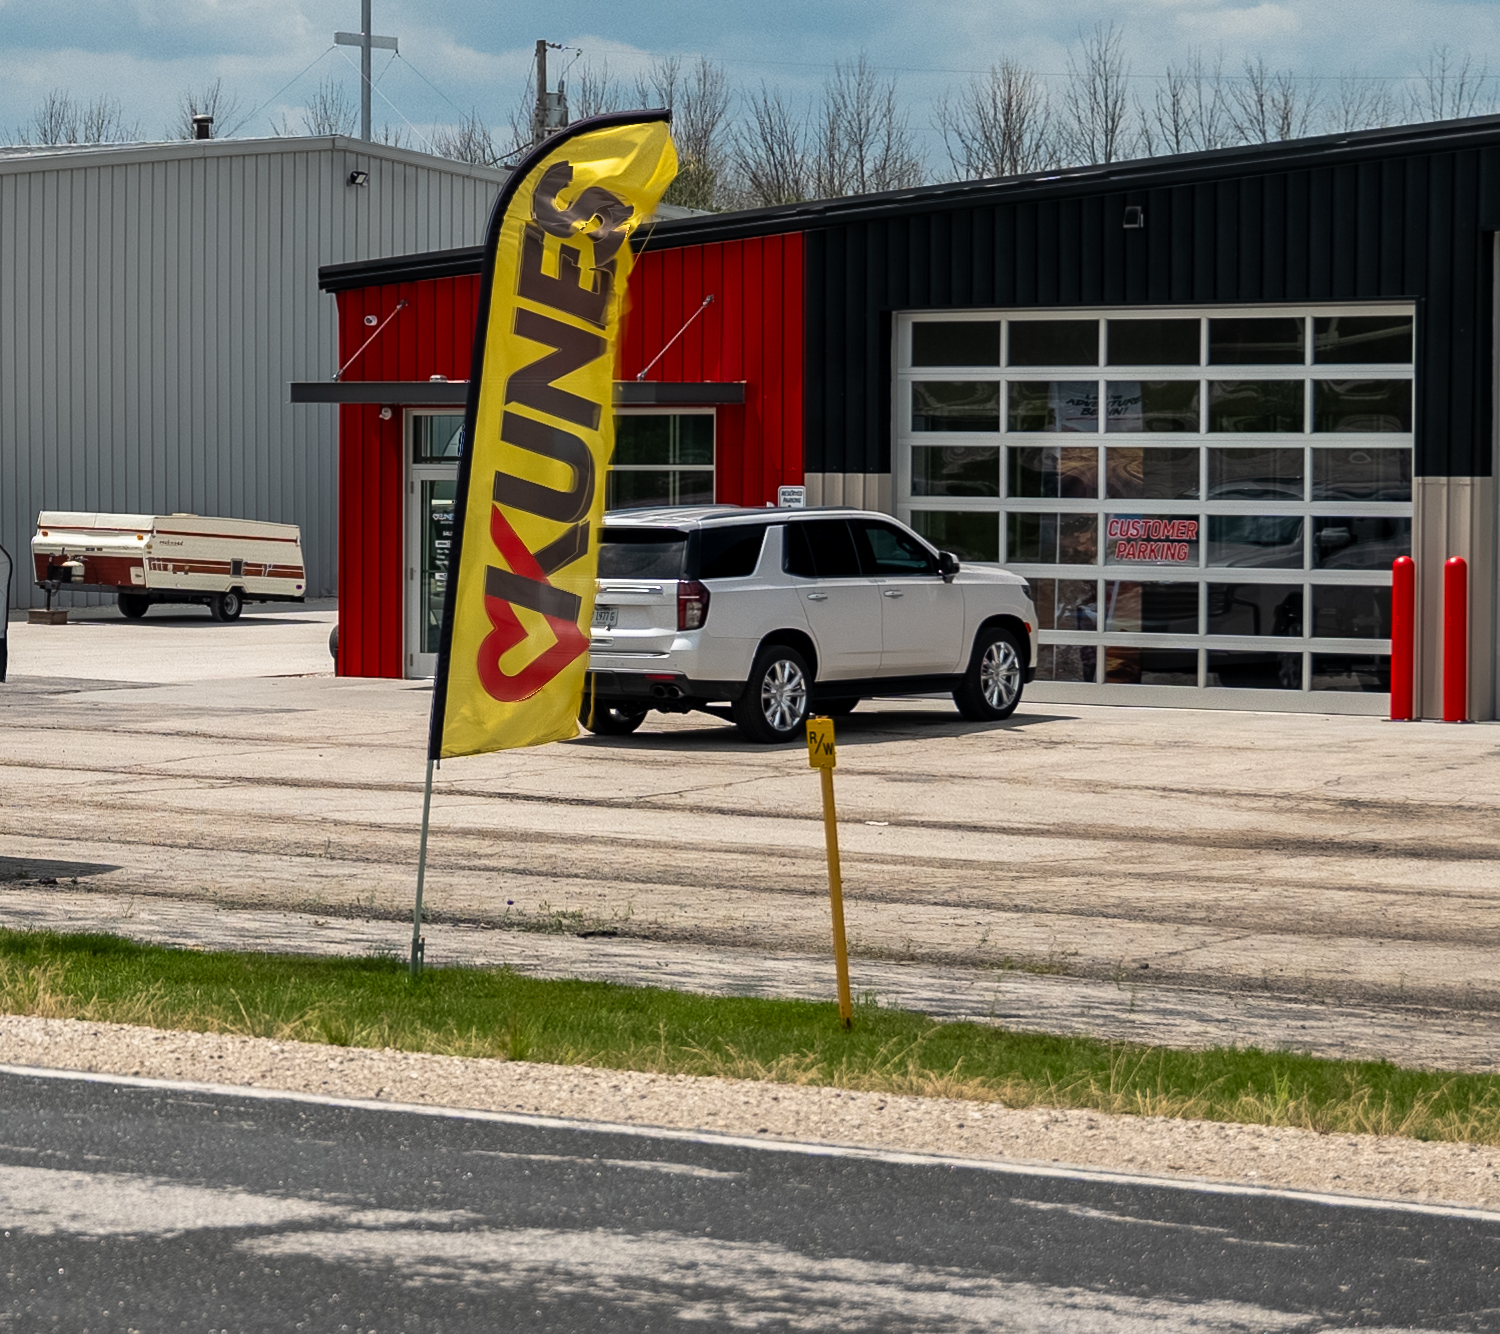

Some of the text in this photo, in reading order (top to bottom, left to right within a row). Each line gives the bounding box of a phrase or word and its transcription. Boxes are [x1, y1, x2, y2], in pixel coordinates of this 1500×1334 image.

[485, 160, 635, 624] KUNES
[1066, 395, 1142, 407] ADVETURE
[1080, 407, 1129, 416] BEIN!
[1108, 518, 1198, 540] CUSTOMER
[1115, 540, 1189, 562] PARKING
[809, 731, 834, 755] R/W
